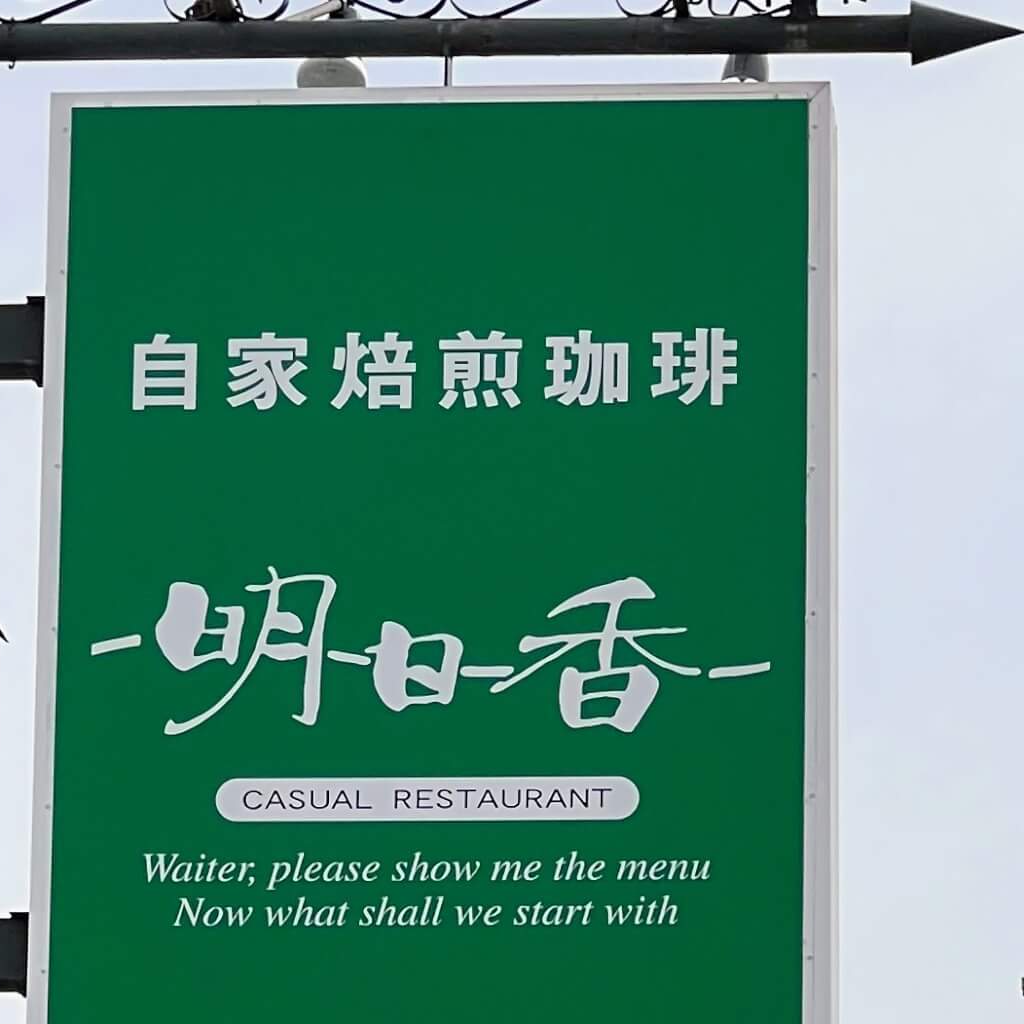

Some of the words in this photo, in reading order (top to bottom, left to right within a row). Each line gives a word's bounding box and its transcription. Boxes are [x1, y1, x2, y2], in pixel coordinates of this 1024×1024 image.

[131, 327, 739, 411] 自家焙煎珈琲
[155, 565, 702, 736] 明日香
[242, 789, 373, 810] CASUAL
[394, 788, 613, 809] RESTAURANT
[144, 853, 256, 887] Waiter,
[266, 852, 381, 891] please
[391, 851, 481, 882] show
[490, 859, 542, 881] me
[553, 851, 606, 881] the
[616, 859, 711, 881] menu
[173, 897, 254, 927] Now
[265, 896, 350, 927] what
[358, 895, 444, 926] shall
[455, 904, 502, 926] we
[513, 901, 594, 926] start
[605, 894, 678, 925] with
